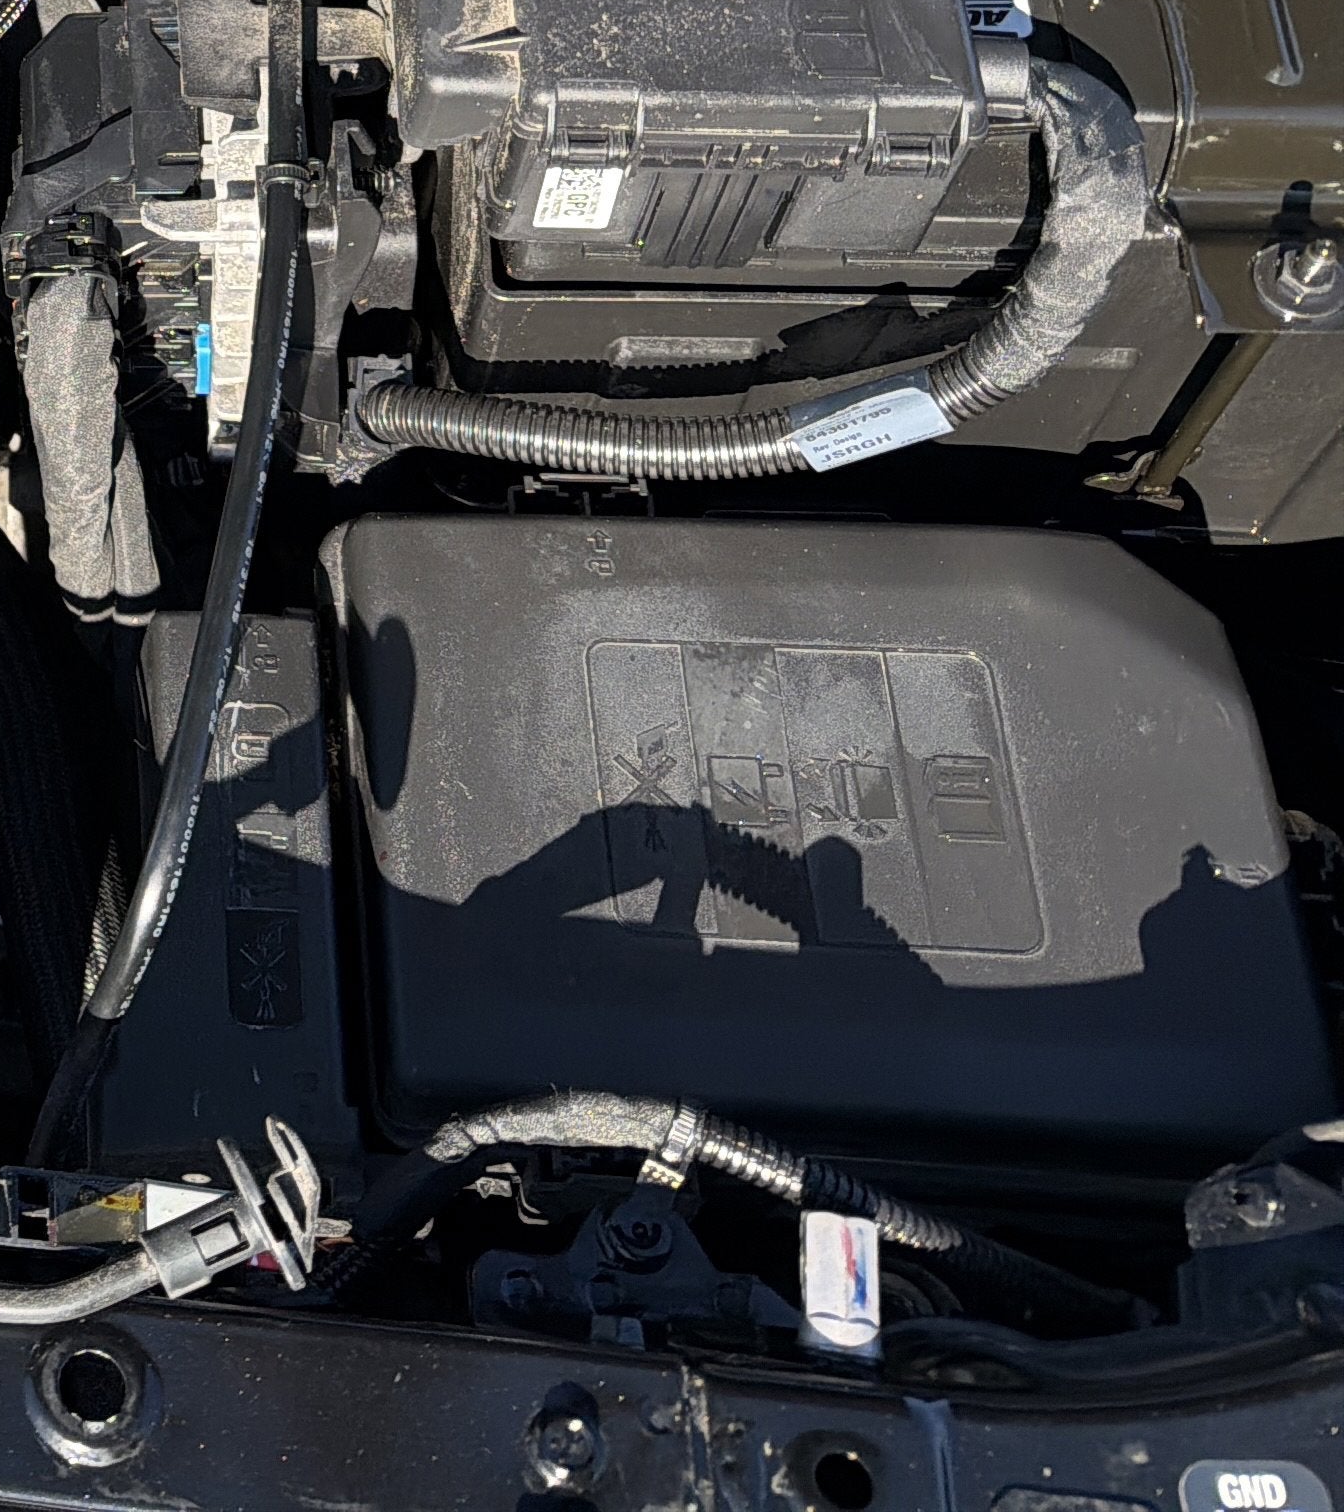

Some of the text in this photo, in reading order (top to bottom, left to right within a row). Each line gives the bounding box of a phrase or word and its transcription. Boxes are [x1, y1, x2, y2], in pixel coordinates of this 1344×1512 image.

[813, 431, 862, 454] Rev Design
[821, 433, 892, 462] JSRGH
[1218, 1473, 1287, 1508] GND
